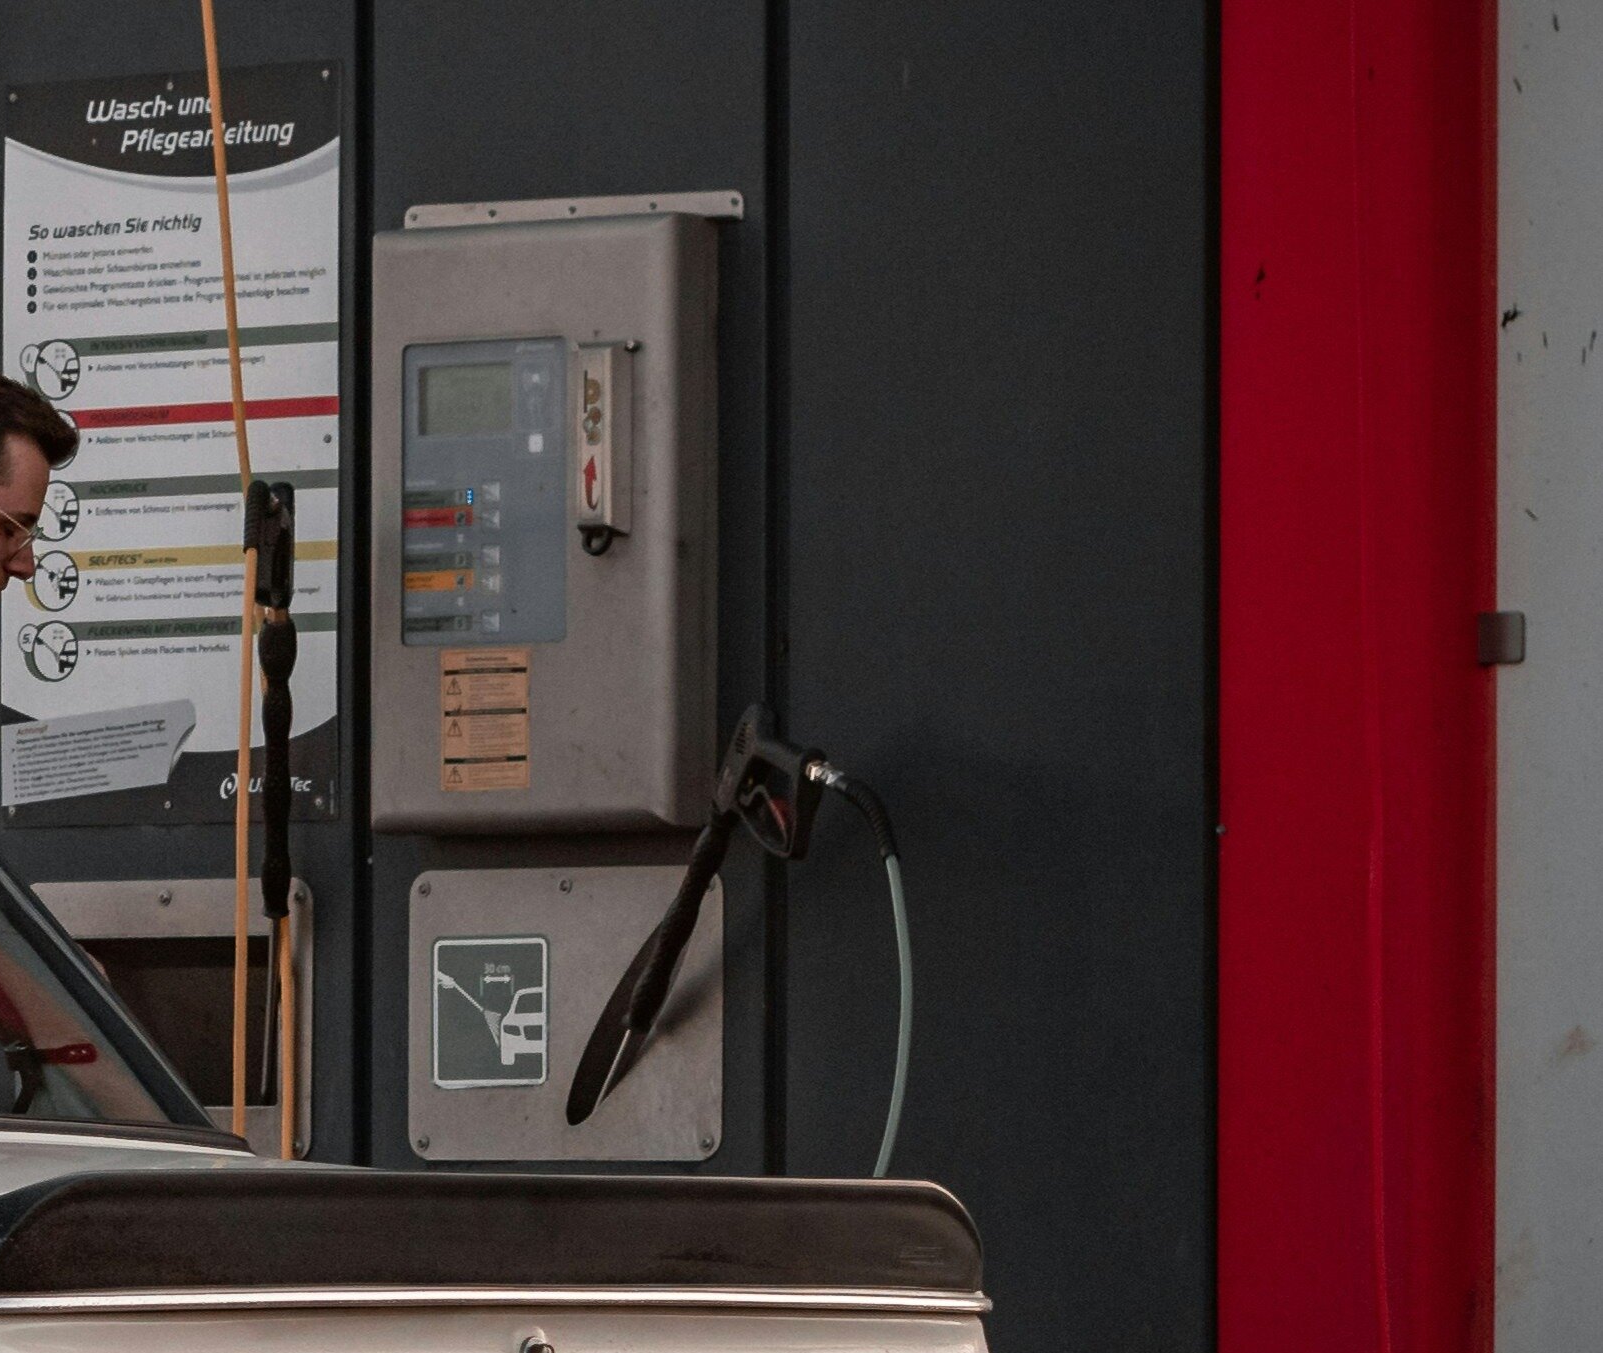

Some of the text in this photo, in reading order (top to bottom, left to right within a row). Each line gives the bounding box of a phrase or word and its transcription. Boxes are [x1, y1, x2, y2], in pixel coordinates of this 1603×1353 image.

[86, 95, 173, 123] Wasch-
[120, 120, 295, 155] Pflegeaneitung
[28, 213, 202, 240] So waschen Sie richtig
